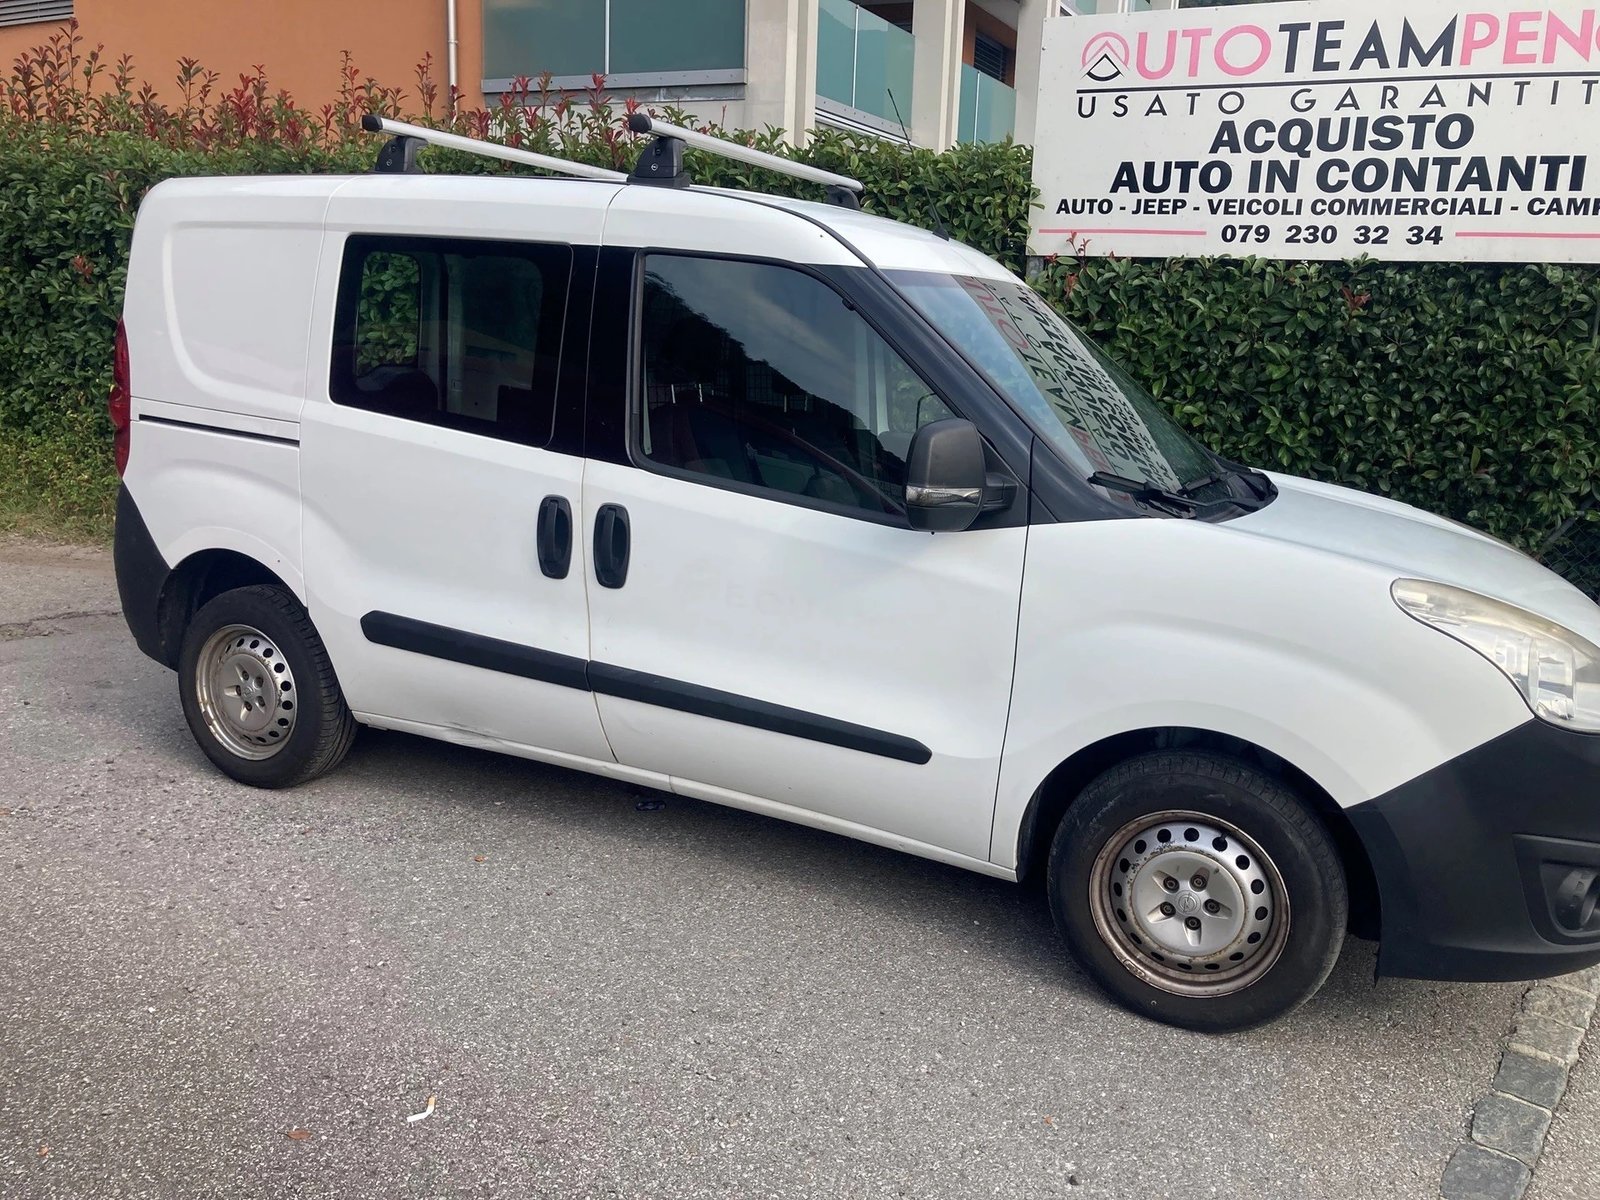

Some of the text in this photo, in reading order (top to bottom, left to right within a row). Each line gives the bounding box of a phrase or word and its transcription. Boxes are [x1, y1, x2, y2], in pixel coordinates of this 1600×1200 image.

[1080, 8, 1600, 82] AUTOTEAMPEN
[1077, 80, 1599, 118] USATO GARANTIT
[1208, 113, 1475, 158] ACQUISTO
[1109, 155, 1588, 194] AUTO IN CONTANTI
[1056, 198, 1114, 215] AUTO
[1131, 198, 1188, 215] JEEP
[1207, 198, 1303, 215] VEICOLI
[1310, 197, 1503, 216] COMMERCIALI
[1220, 225, 1444, 245] 079 230 32 34
